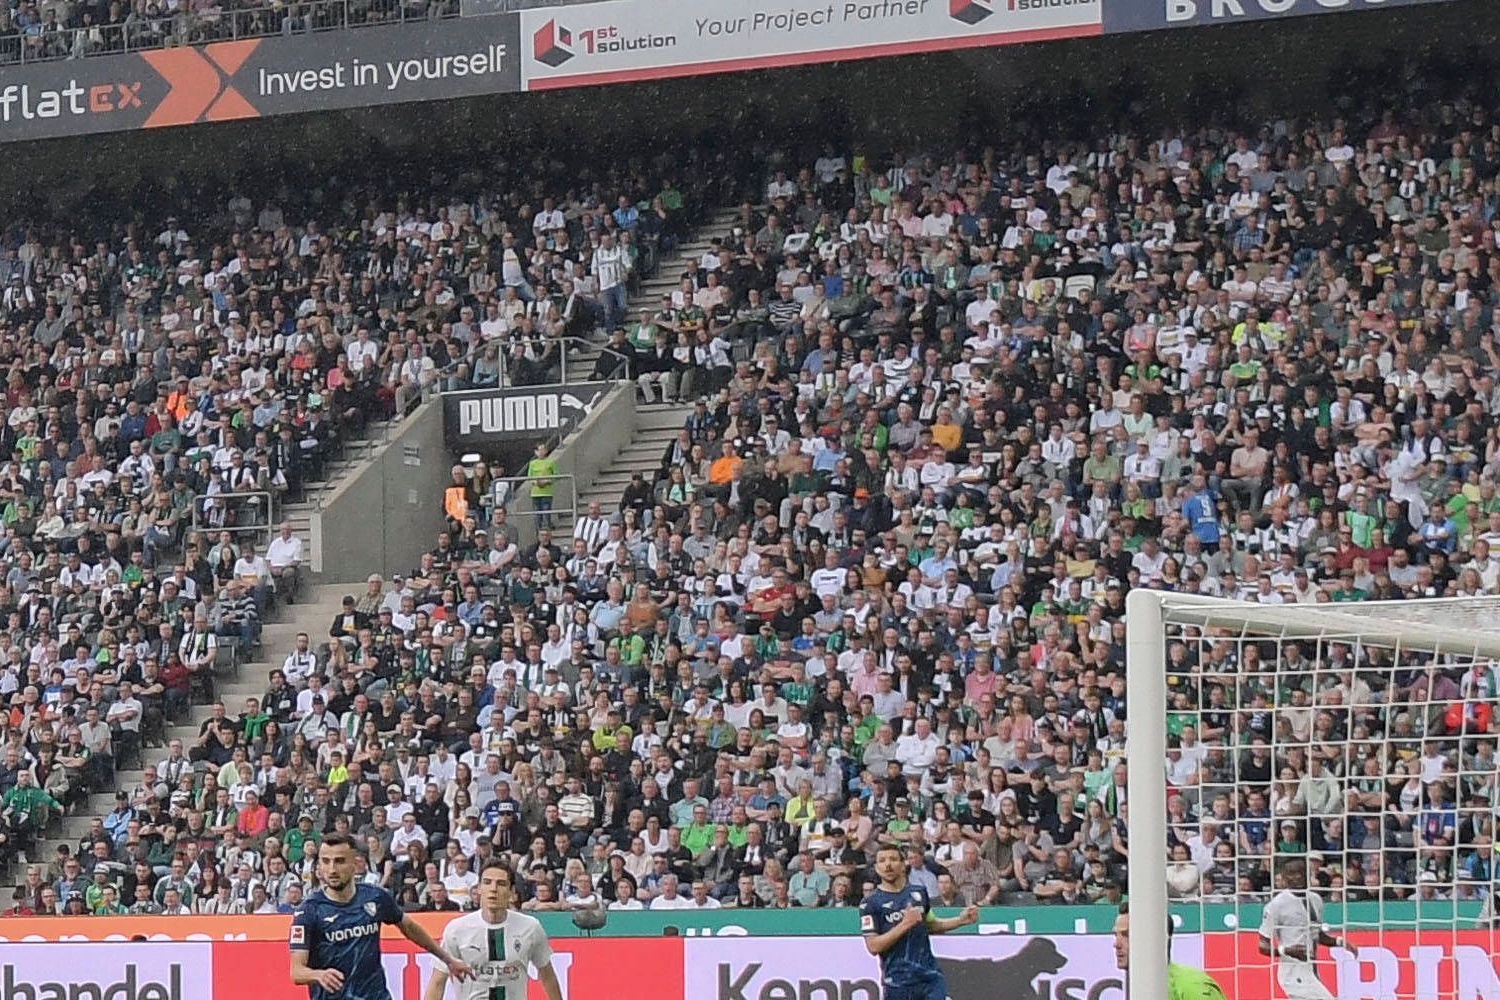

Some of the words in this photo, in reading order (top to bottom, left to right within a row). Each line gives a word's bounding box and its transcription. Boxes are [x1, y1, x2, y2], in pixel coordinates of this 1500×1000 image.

[695, 18, 746, 38] Your
[753, 5, 833, 32] Project
[843, 0, 929, 22] Partner
[578, 24, 618, 54] 1st
[596, 34, 677, 54] solution
[258, 62, 345, 96] Invest
[353, 58, 378, 87] in
[387, 43, 507, 90] yourself
[459, 393, 559, 435] PUMA
